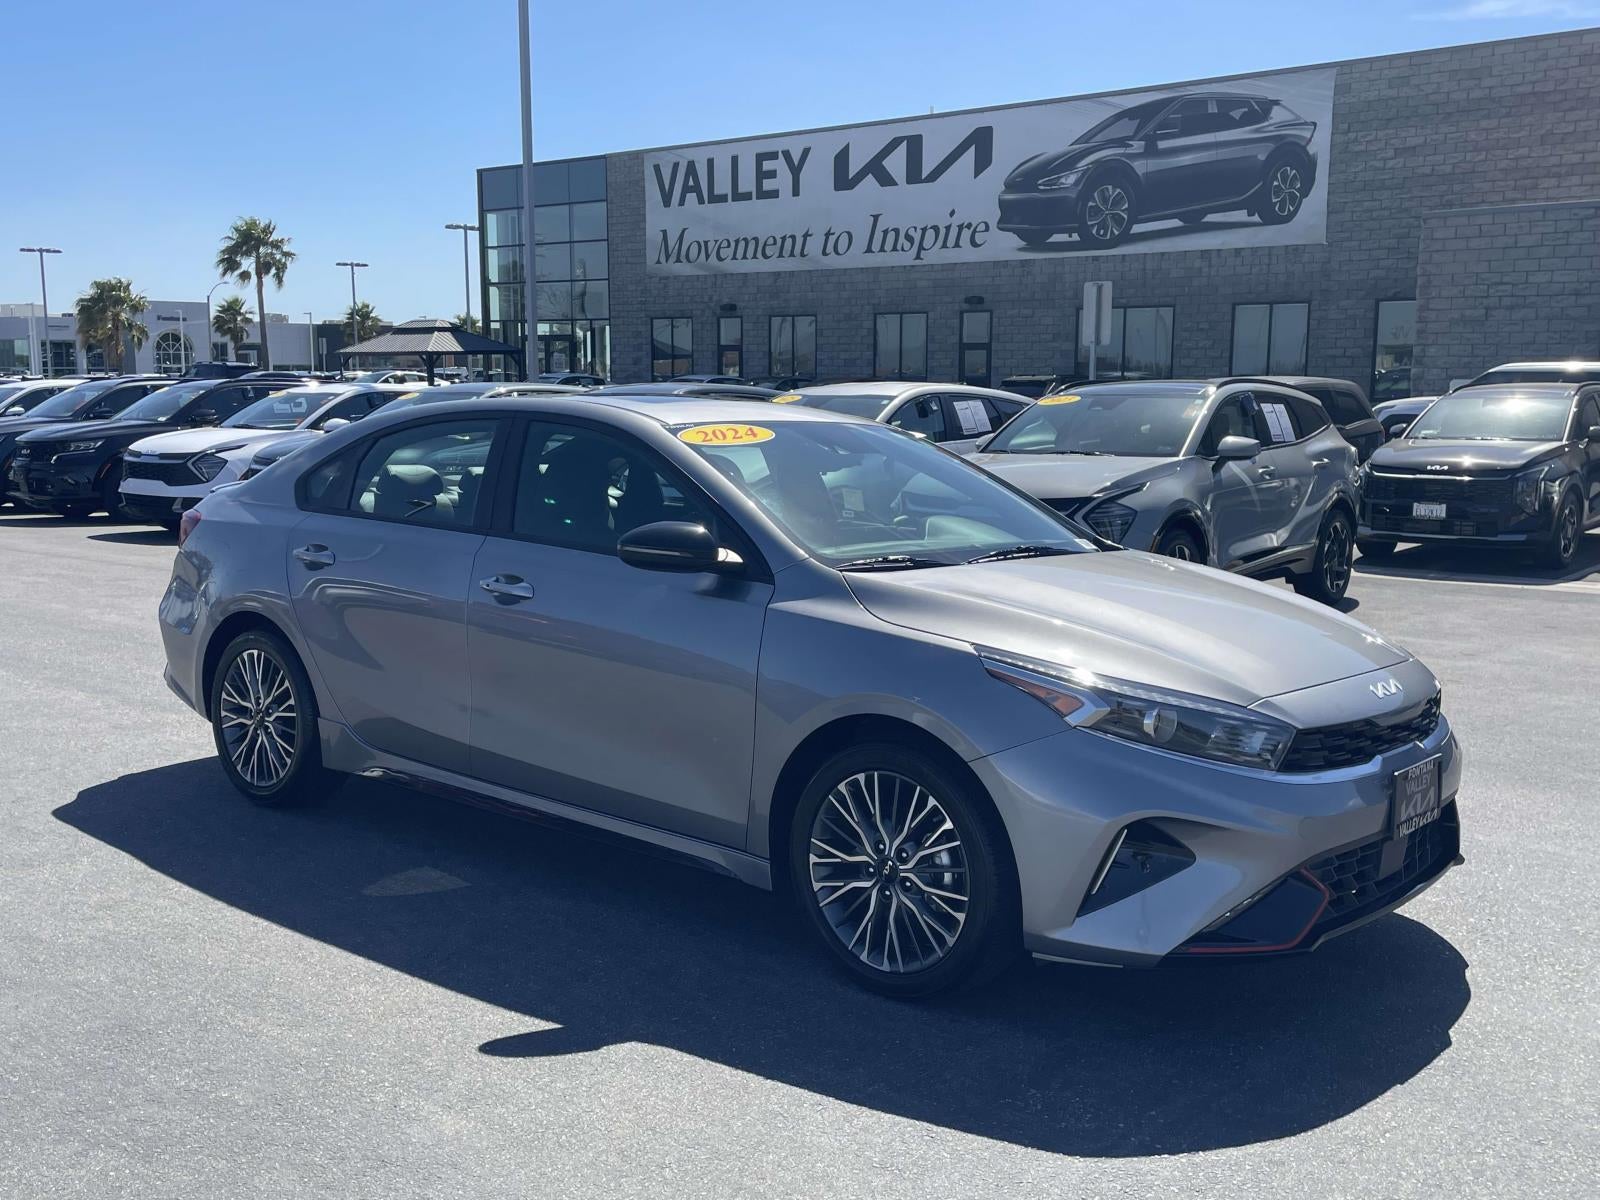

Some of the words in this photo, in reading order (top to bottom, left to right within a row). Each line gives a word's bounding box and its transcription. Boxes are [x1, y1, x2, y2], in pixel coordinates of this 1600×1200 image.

[652, 146, 812, 208] VALLEY
[833, 125, 994, 192] KIA
[655, 227, 814, 265] Movement
[821, 226, 853, 257] to
[862, 208, 990, 261] Inspire
[696, 427, 758, 442] 2024
[1370, 679, 1403, 699] KIA
[1406, 772, 1431, 796] VALLEY
[1399, 815, 1421, 838] VALLEY
